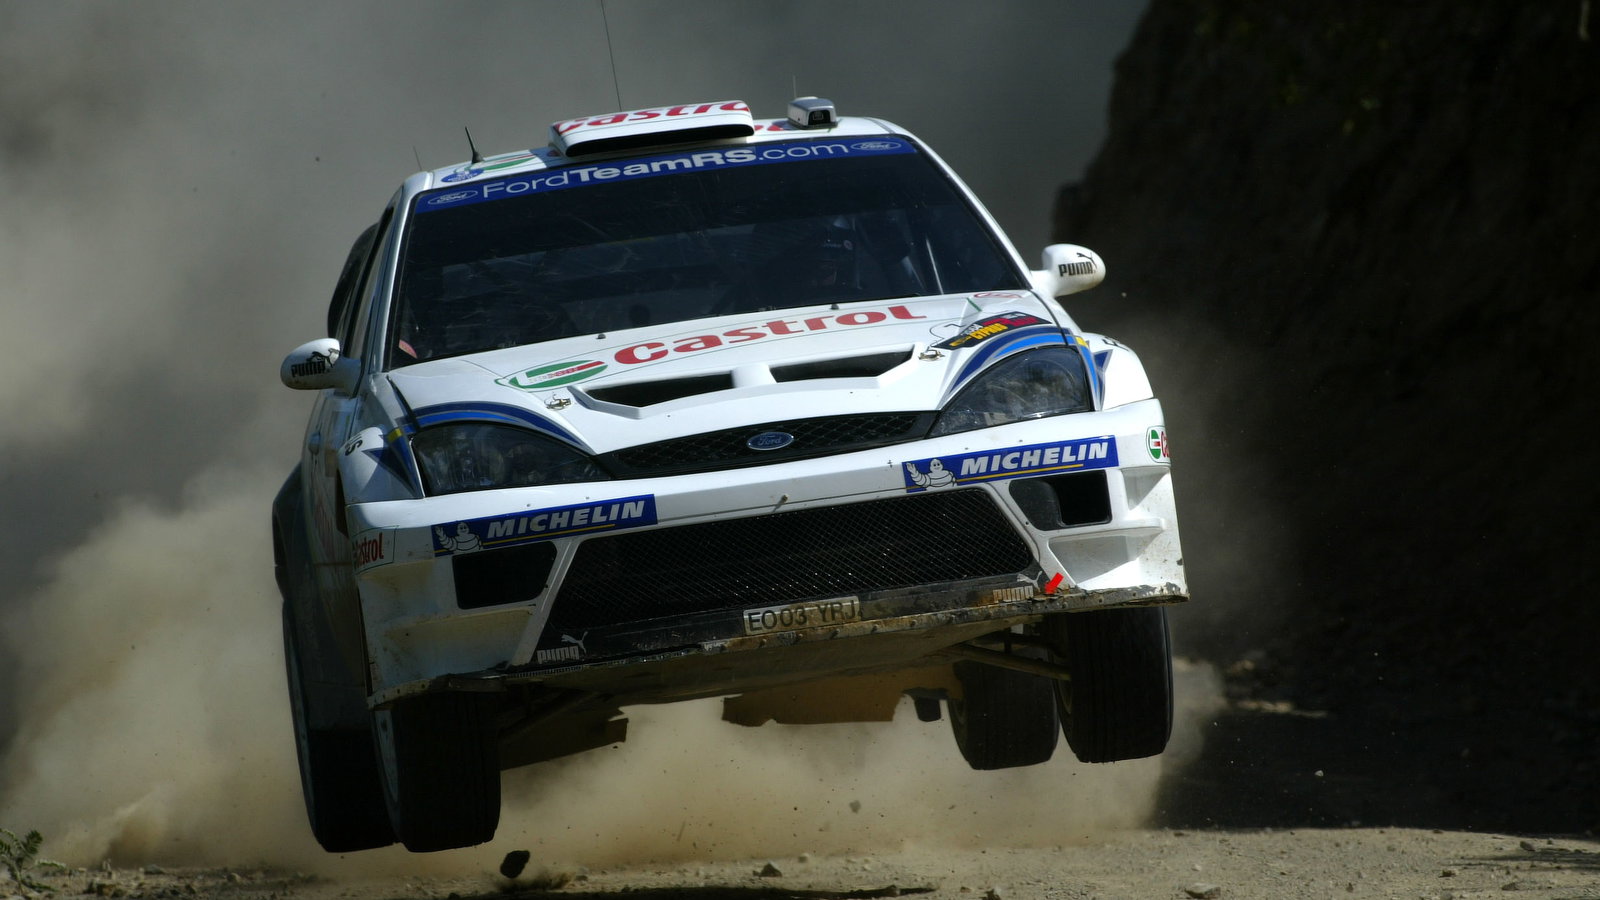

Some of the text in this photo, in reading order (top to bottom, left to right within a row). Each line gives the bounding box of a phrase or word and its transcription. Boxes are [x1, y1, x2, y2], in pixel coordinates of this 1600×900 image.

[482, 142, 849, 198] FordTeamRS.com
[1058, 261, 1094, 277] PUMA
[614, 305, 926, 365] Castrol
[291, 361, 326, 377] PUMA
[960, 441, 1109, 476] MICHELIN
[486, 500, 646, 539] MICHELIN
[817, 599, 857, 623] YRJ
